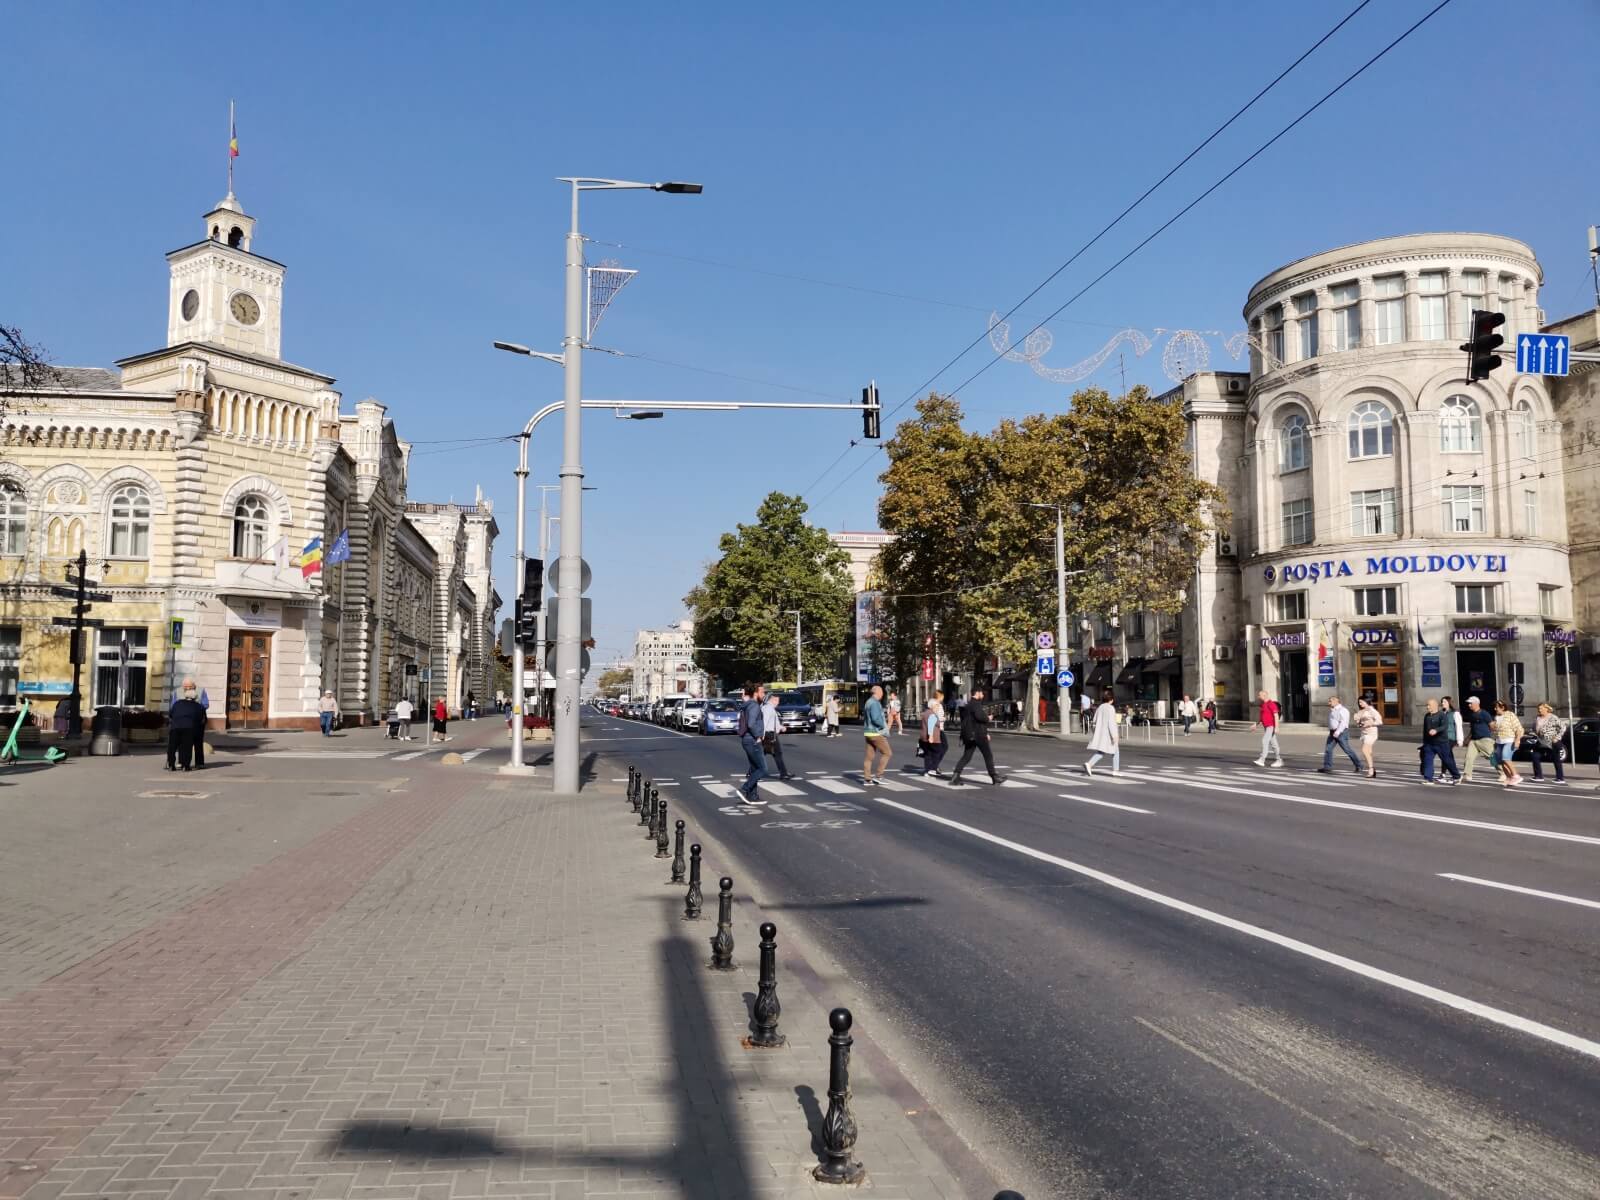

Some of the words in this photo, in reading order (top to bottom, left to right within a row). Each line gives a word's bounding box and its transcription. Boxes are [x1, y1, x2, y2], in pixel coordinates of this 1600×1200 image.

[1366, 554, 1507, 575] MOLDOVEI
[1352, 628, 1398, 644] ODA
[1452, 626, 1517, 641] moldcell
